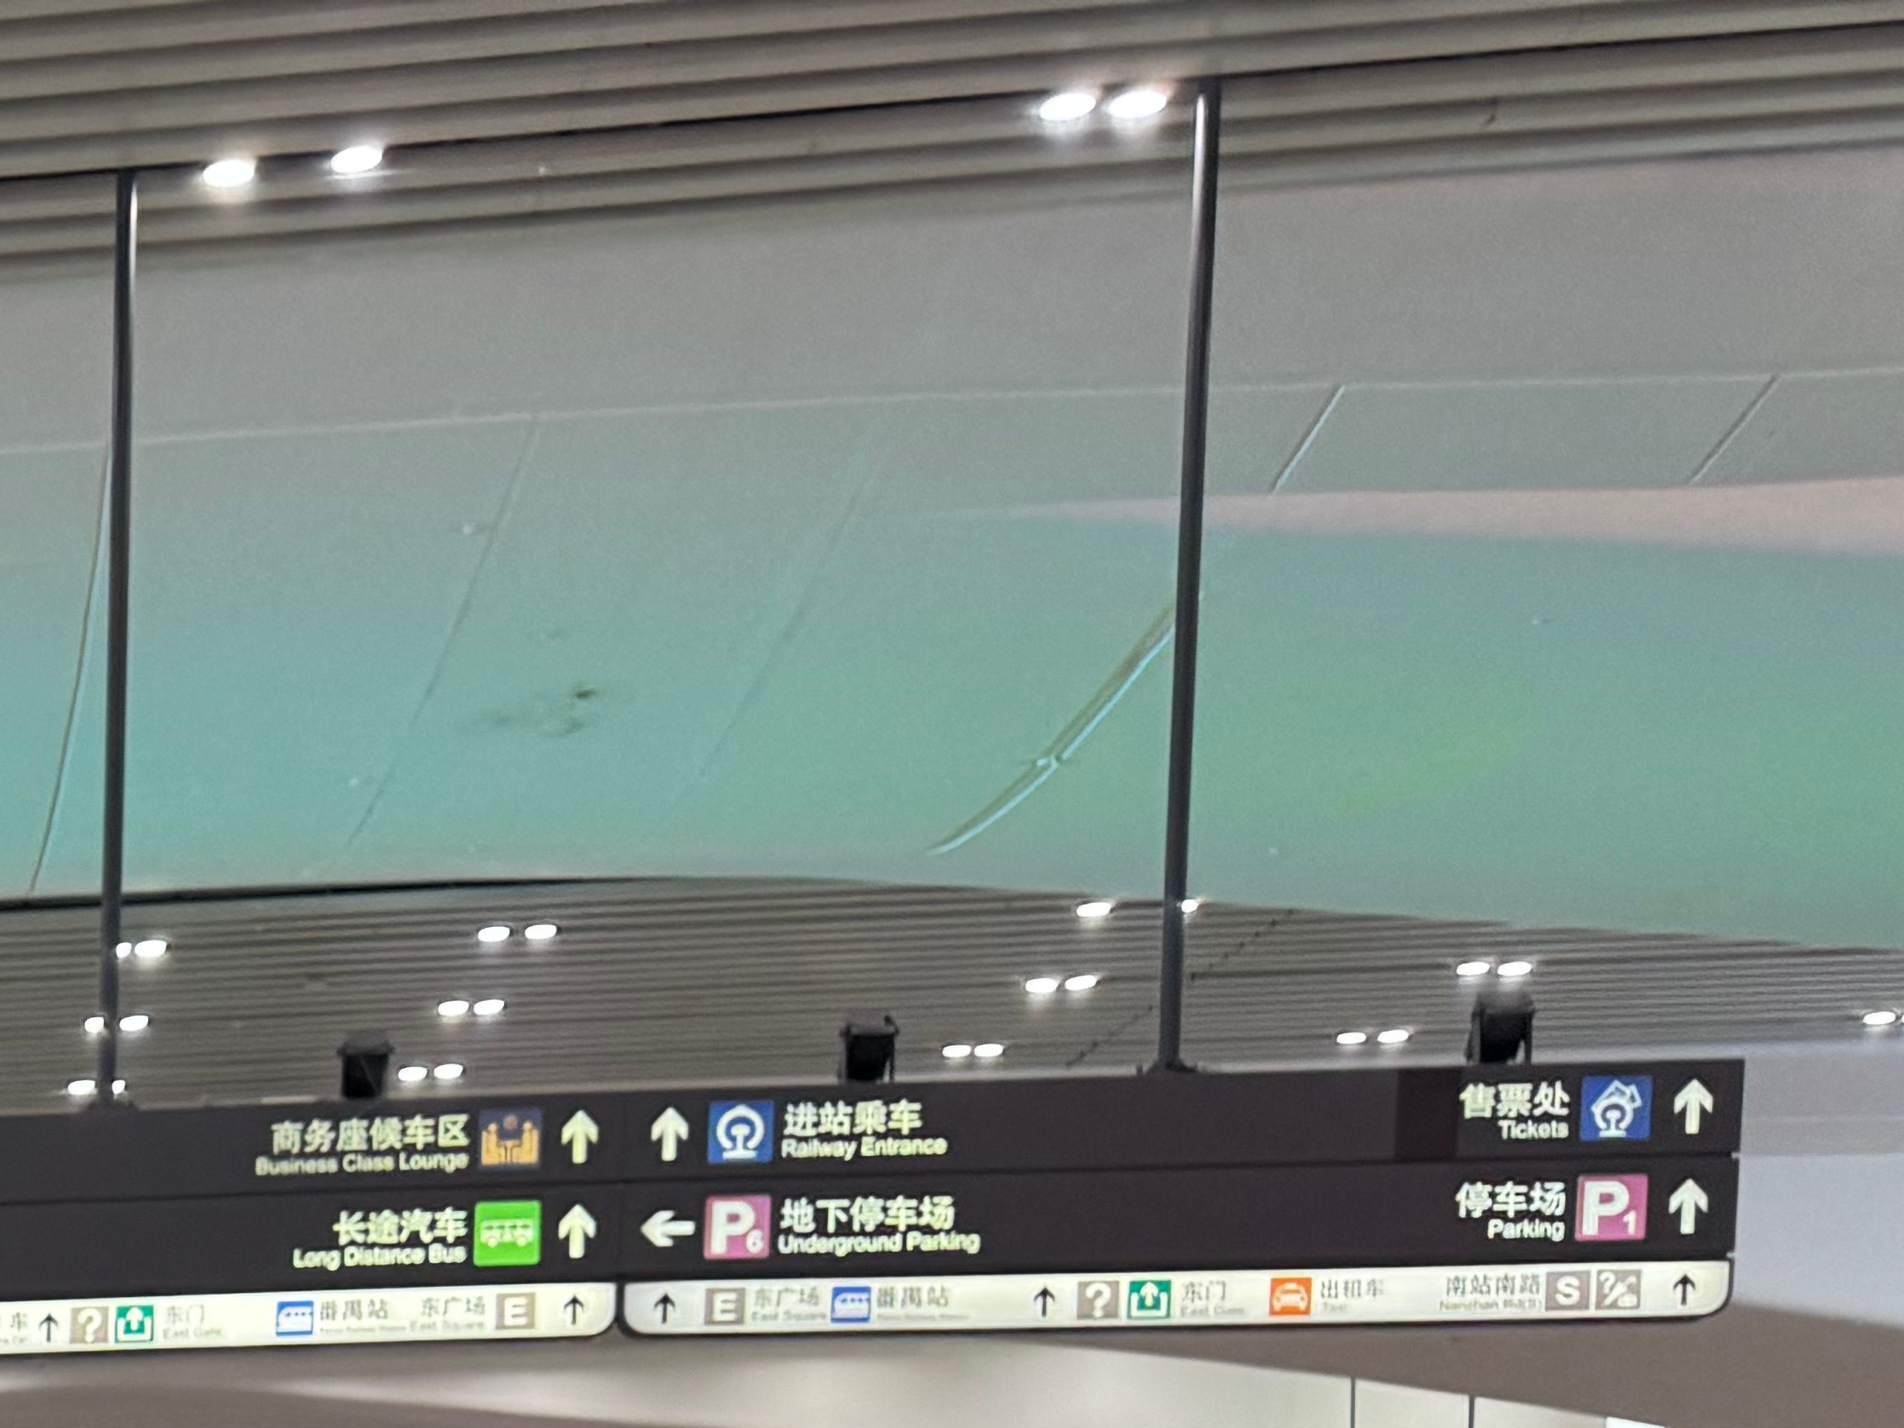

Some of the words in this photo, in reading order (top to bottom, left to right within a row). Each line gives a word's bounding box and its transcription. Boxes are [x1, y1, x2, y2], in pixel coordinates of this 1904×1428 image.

[1459, 1083, 1569, 1119] 售票处
[784, 1099, 923, 1136] 进站乘车
[1499, 1119, 1569, 1139] Tickets
[272, 1113, 470, 1153] 商务座候车区
[782, 1137, 857, 1161] Railway
[861, 1135, 948, 1157] Entrance
[255, 1156, 337, 1176] Business
[343, 1154, 395, 1173] Class
[398, 1151, 469, 1174] Lounge
[1455, 1181, 1566, 1218] 停车场
[333, 1207, 468, 1245] 长途汽车
[780, 1195, 955, 1234] 地下停车场
[1488, 1217, 1566, 1240] Parking
[294, 1247, 340, 1271] Long
[344, 1246, 425, 1266] Distance
[429, 1243, 467, 1264] Bus
[778, 1232, 903, 1256] Underground
[906, 1230, 981, 1254] Parking
[165, 1305, 205, 1325] 东门
